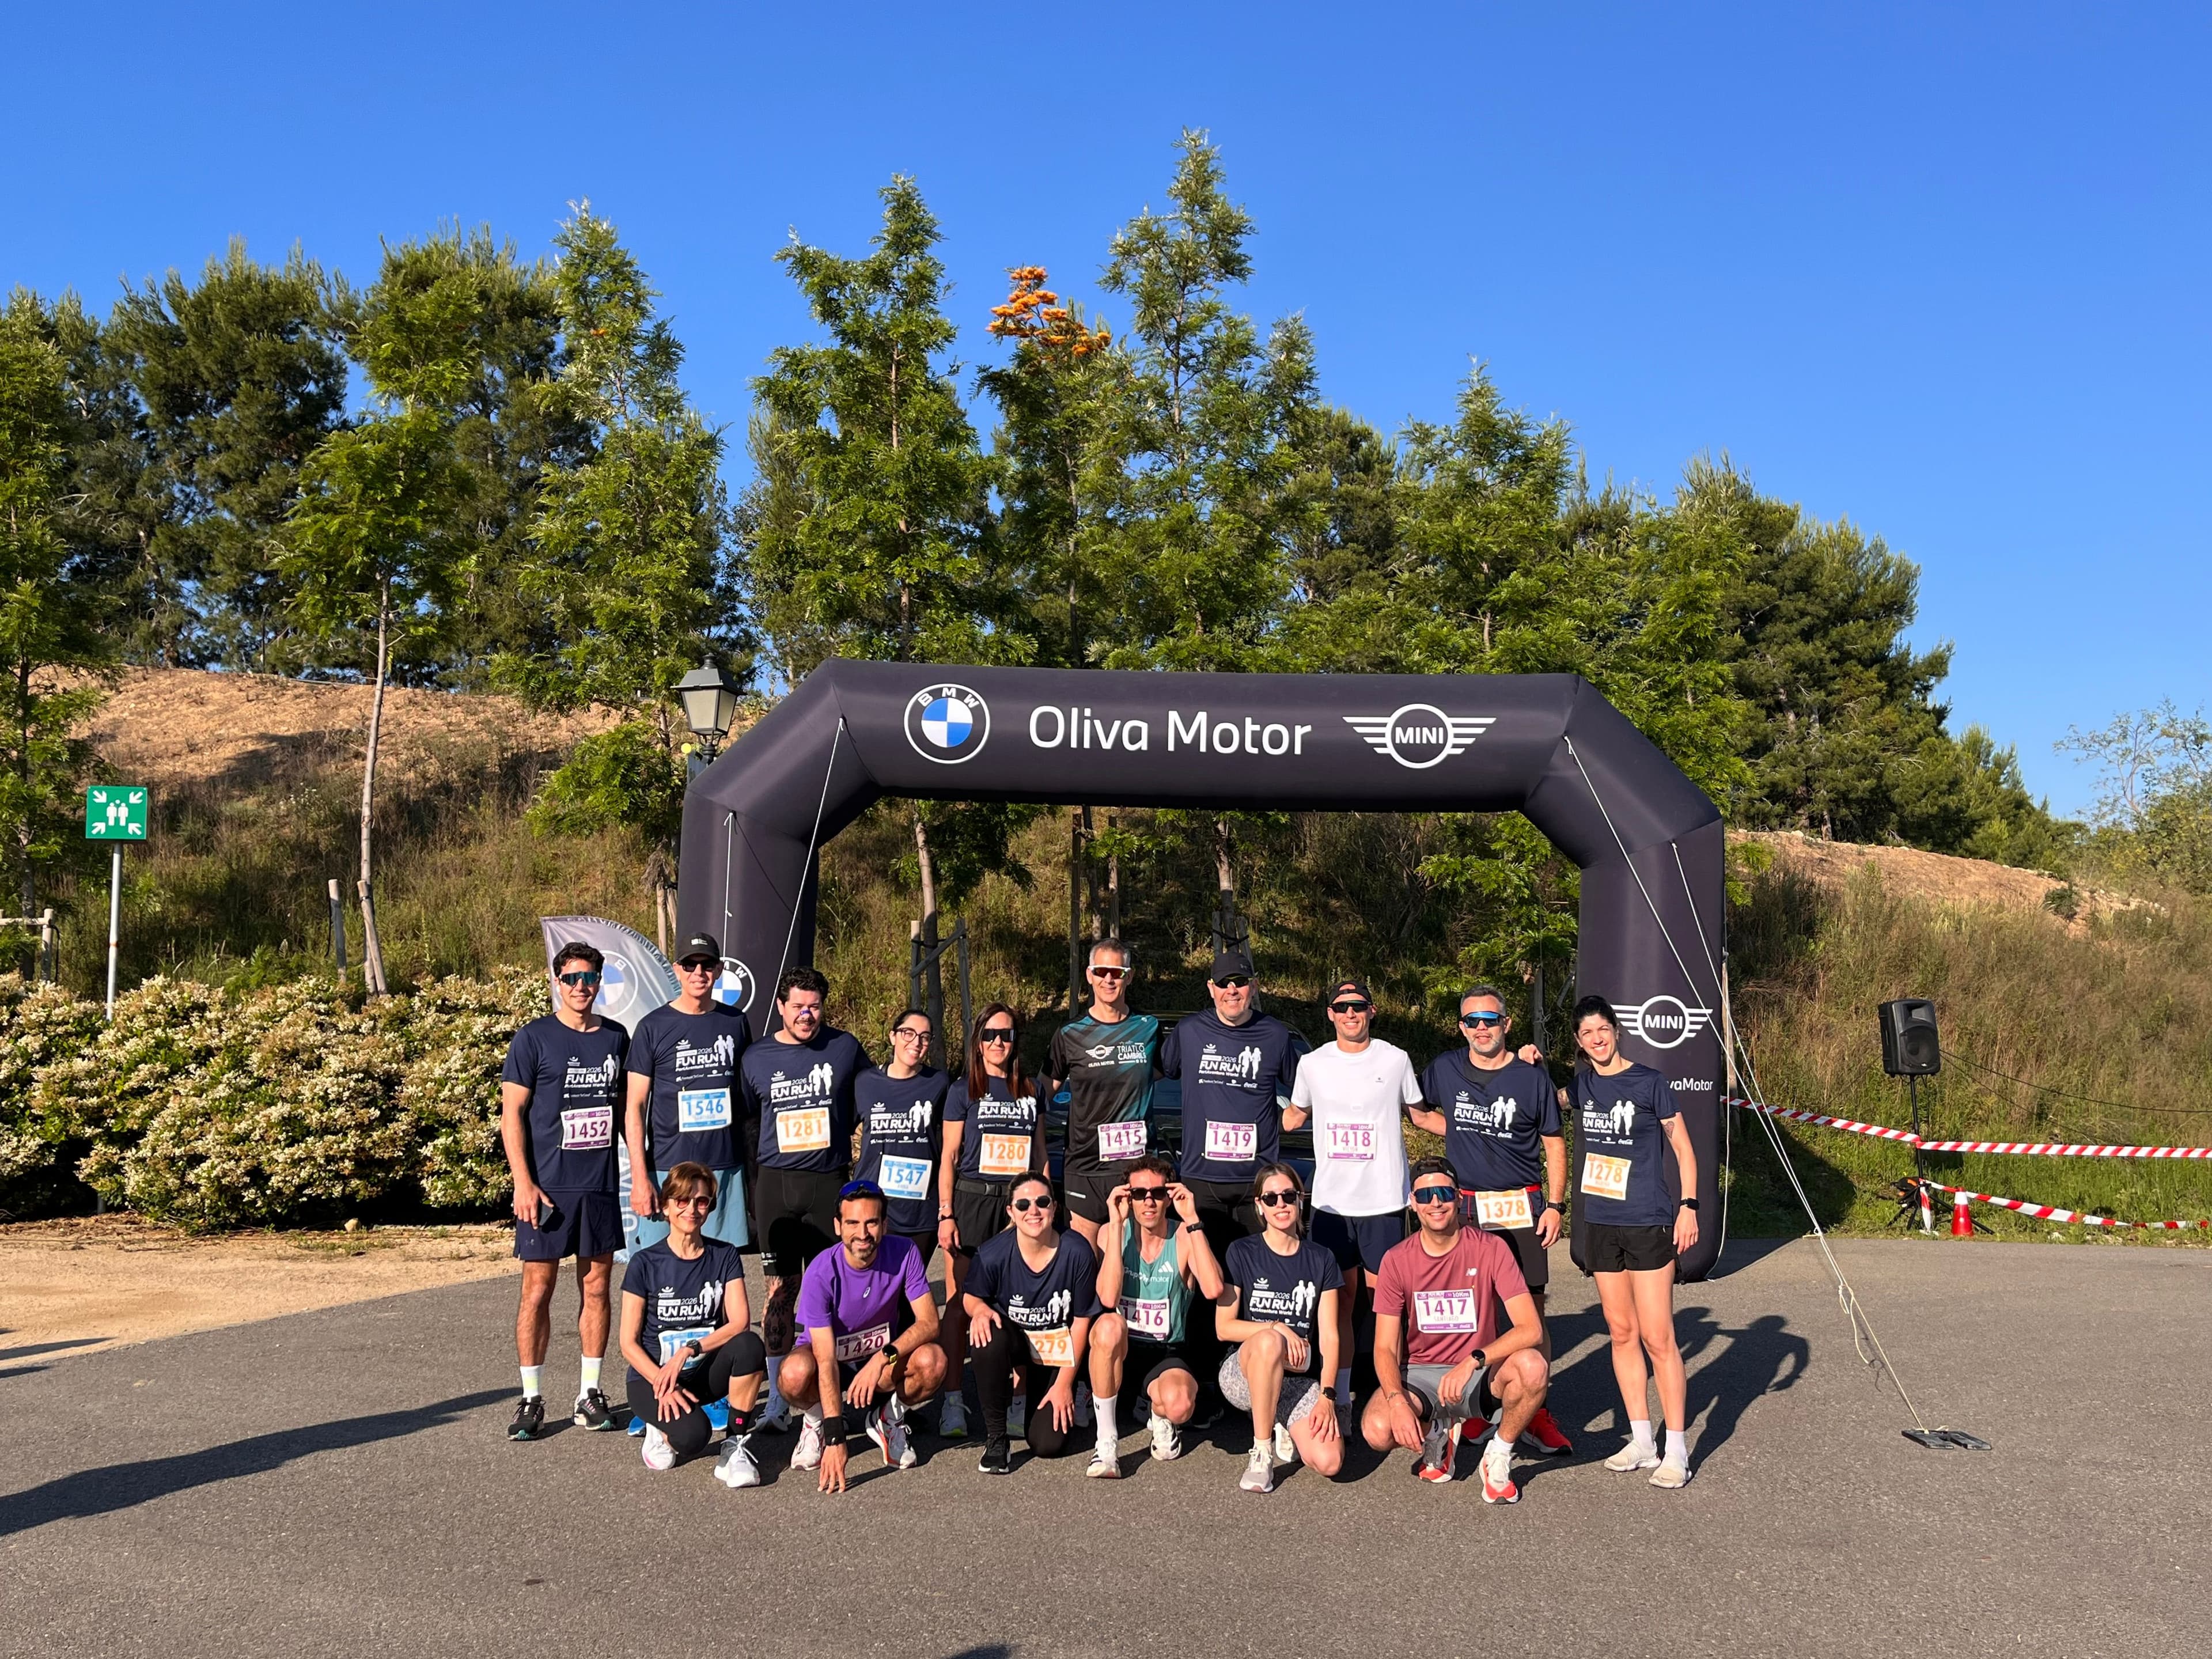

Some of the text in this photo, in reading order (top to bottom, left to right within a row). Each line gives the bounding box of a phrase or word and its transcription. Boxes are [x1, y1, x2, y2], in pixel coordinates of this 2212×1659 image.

[918, 687, 979, 708] BMW
[1029, 706, 1312, 755] Oliva Motor
[1395, 727, 1444, 744] MINI
[1645, 1014, 1683, 1029] MINI
[676, 1053, 718, 1067] FUN RUN
[1199, 1060, 1241, 1073] FUN RUN
[565, 1073, 607, 1084] FUN RUN
[1667, 1077, 1713, 1090] vaMotor
[771, 1083, 812, 1099] FUN RUN
[686, 1099, 724, 1116] 1546
[978, 1107, 1021, 1115] FUN RUN
[1454, 1108, 1471, 1119] FUN
[1472, 1111, 1493, 1122] RUN
[570, 1120, 608, 1139] 1452
[783, 1119, 821, 1138] 1281
[870, 1119, 912, 1130] FUN RUN
[1594, 1119, 1613, 1129] RUN
[1106, 1130, 1142, 1147] 1415
[1213, 1131, 1251, 1147] 1419
[1332, 1131, 1370, 1147] 1418
[988, 1143, 1026, 1160] 1280
[887, 1168, 924, 1185] 1547
[1589, 1162, 1622, 1183] 1278
[1483, 1199, 1525, 1219] 1378
[657, 1304, 703, 1317] FUN RUN
[1249, 1297, 1295, 1310] FUN RUN
[1423, 1299, 1467, 1316] 1417
[1028, 1312, 1051, 1322] RUN
[1123, 1308, 1163, 1326] 1416
[843, 1335, 884, 1357] 1420
[1035, 1339, 1067, 1354] 279
